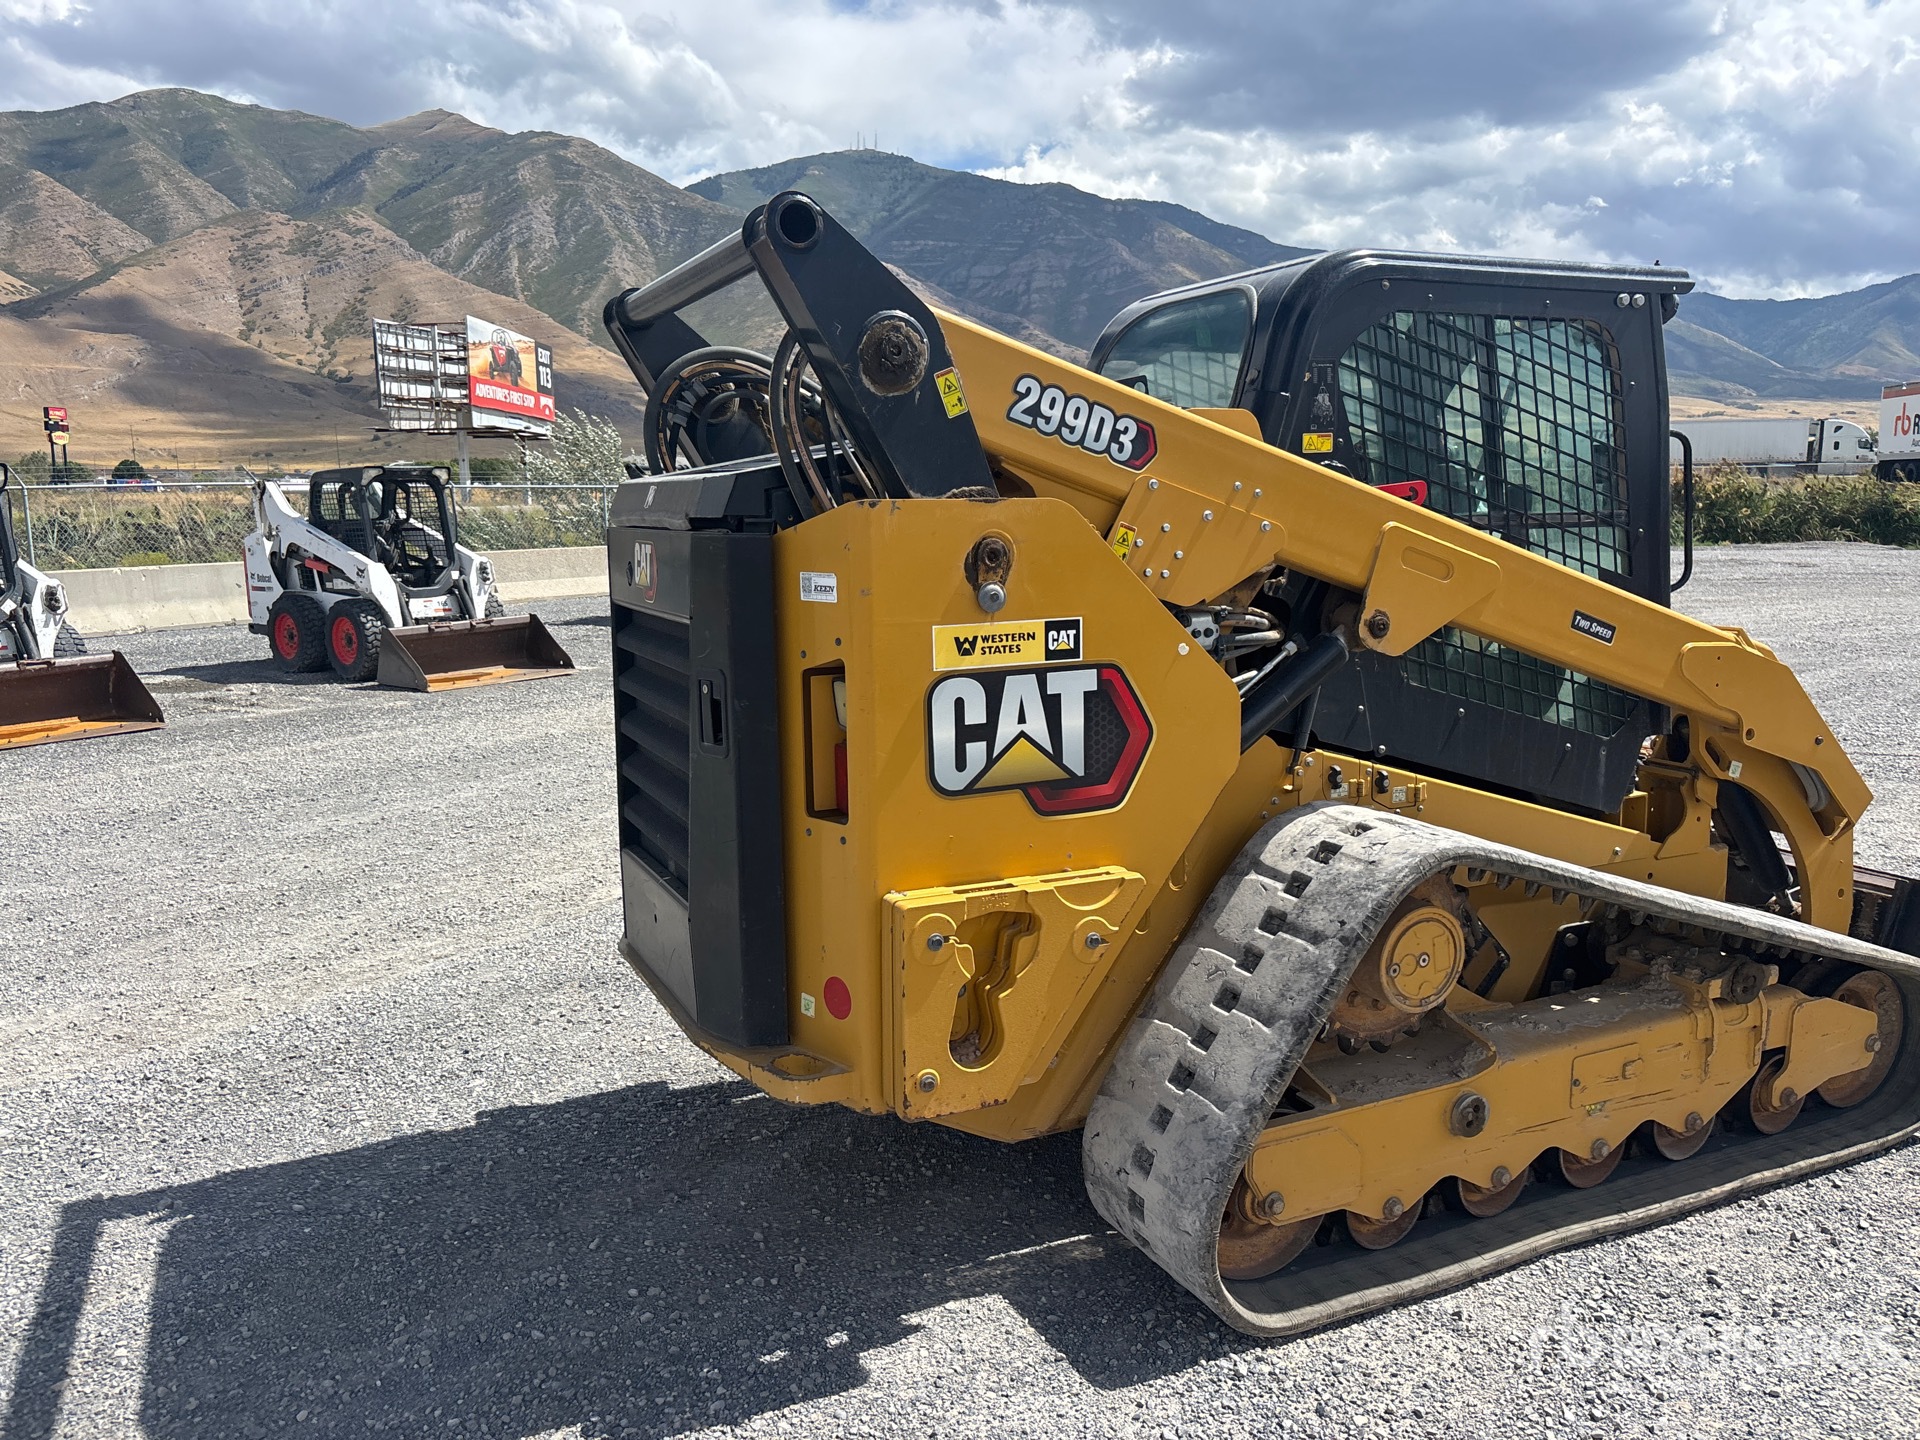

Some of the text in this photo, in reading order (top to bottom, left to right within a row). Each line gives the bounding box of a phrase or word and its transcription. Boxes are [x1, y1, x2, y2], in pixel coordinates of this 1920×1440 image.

[537, 347, 551, 364] EXIT
[538, 366, 552, 389] 113
[1009, 377, 1138, 462] 299D3
[634, 542, 652, 587] CAT
[813, 584, 835, 593] KEEN
[980, 632, 1036, 644] WESTERN
[1048, 629, 1076, 651] CAT
[980, 644, 1021, 655] STATES
[931, 668, 1098, 791] CAT
